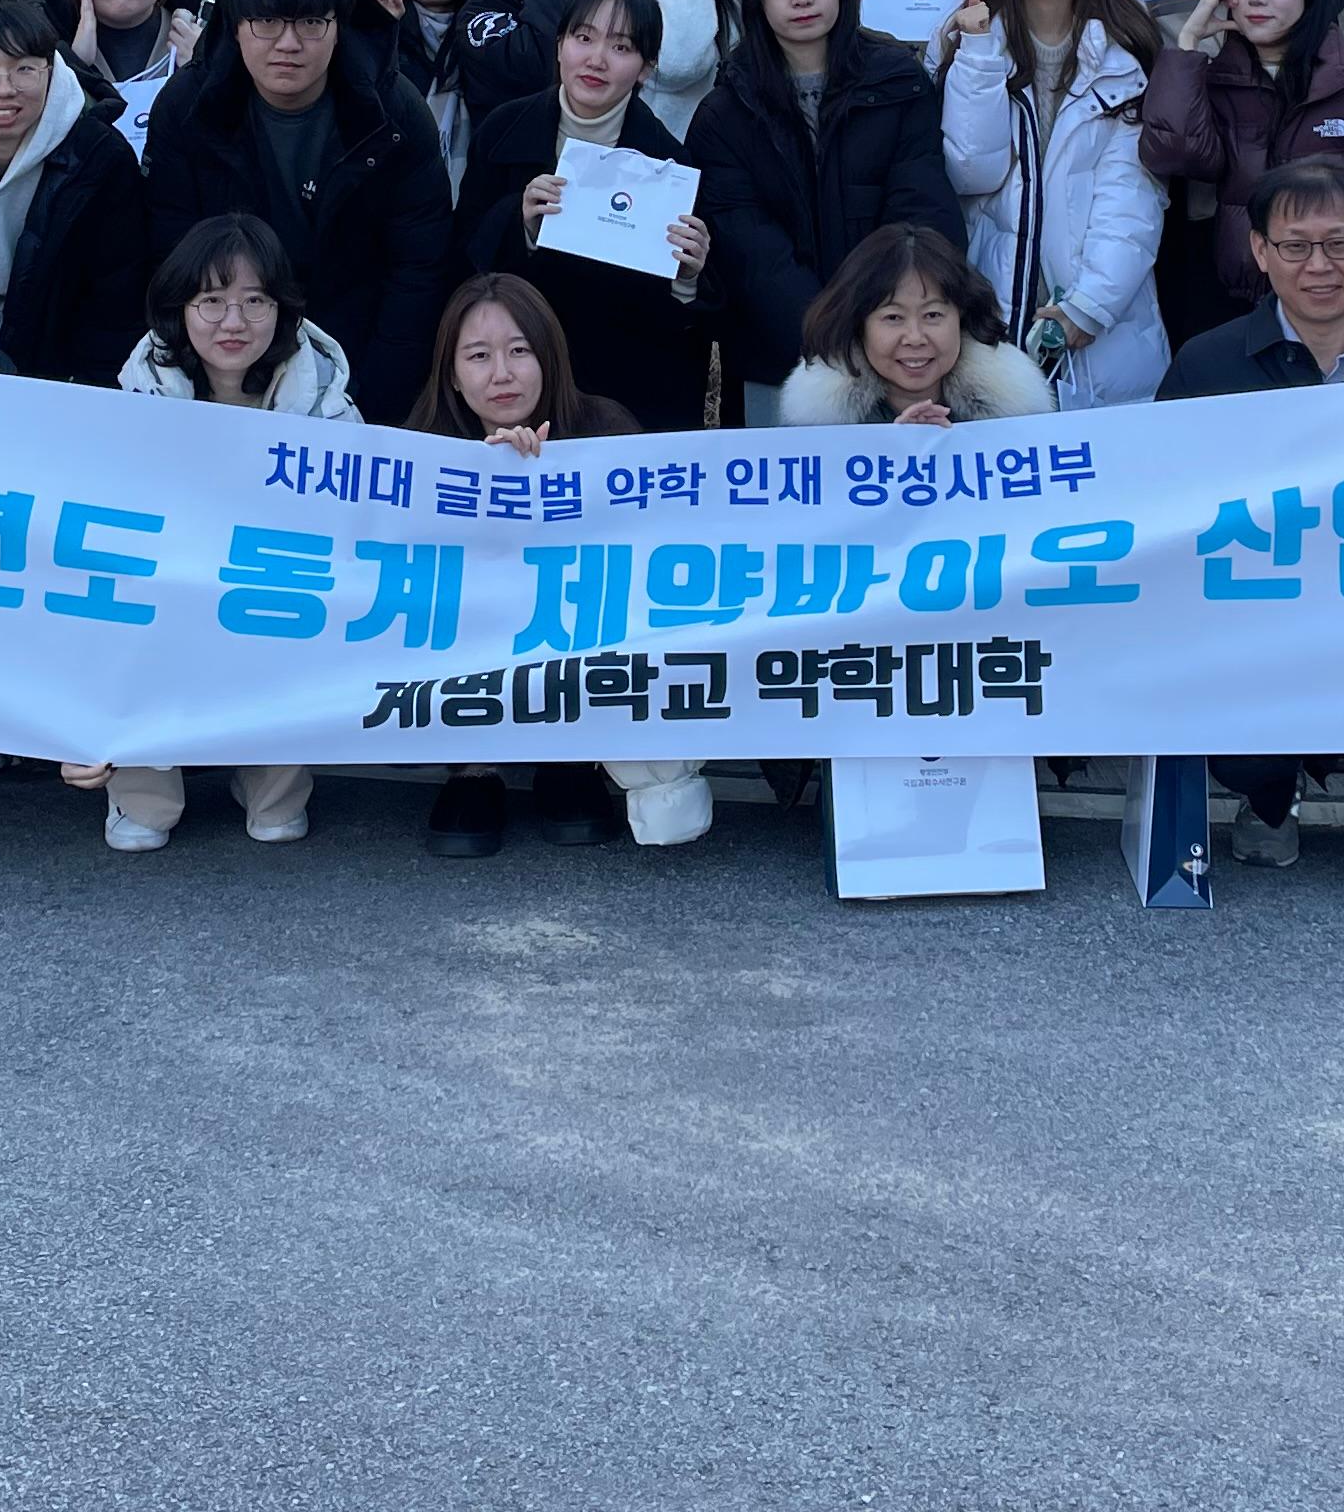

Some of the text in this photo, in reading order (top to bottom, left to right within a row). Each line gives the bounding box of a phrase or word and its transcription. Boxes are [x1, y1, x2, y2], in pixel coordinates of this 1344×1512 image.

[265, 441, 1097, 522] 차세대 글로벌 약학 인재 양성사업부
[218, 525, 464, 651] 동계
[512, 519, 1141, 655] 제약바이오
[362, 636, 1052, 729] 계명대학교 약학대학
